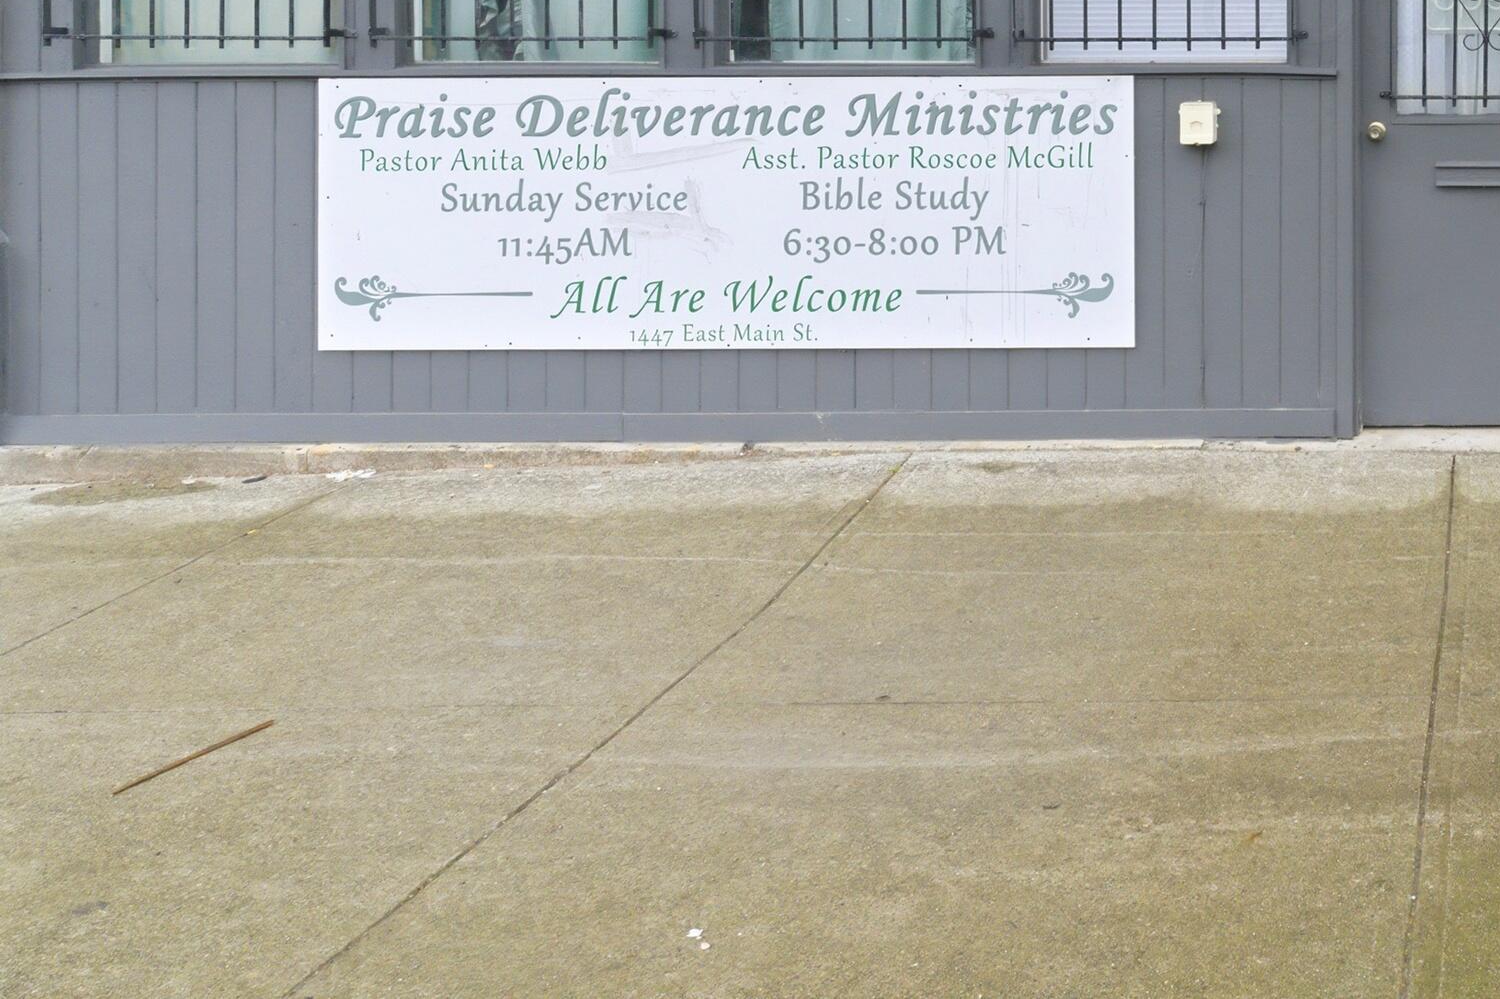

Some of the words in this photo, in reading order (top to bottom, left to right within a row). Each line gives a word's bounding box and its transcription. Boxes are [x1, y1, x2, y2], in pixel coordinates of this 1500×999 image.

[335, 93, 496, 139] Praise
[516, 88, 825, 138] Deliverance
[845, 90, 1118, 138] Ministries
[360, 148, 443, 171] Pastor
[451, 148, 525, 171] Anita
[533, 144, 608, 171] Webb
[743, 147, 806, 169] Asst.
[817, 146, 900, 169] Pastor
[909, 146, 997, 169] Roscoe
[1008, 142, 1094, 169] McGill
[441, 178, 563, 222] Sunday
[575, 182, 688, 212] Service
[800, 177, 882, 211] Bible
[896, 176, 989, 221] Study
[498, 228, 632, 265] 11:45AM
[784, 227, 939, 264] 6:30-8:00
[952, 226, 1006, 256] PM
[550, 275, 626, 319] All
[629, 280, 706, 319] Are
[724, 275, 903, 314] Welcome
[629, 328, 674, 347] 1447
[683, 324, 726, 343] East
[734, 324, 785, 343] Main
[792, 323, 818, 342] St.
